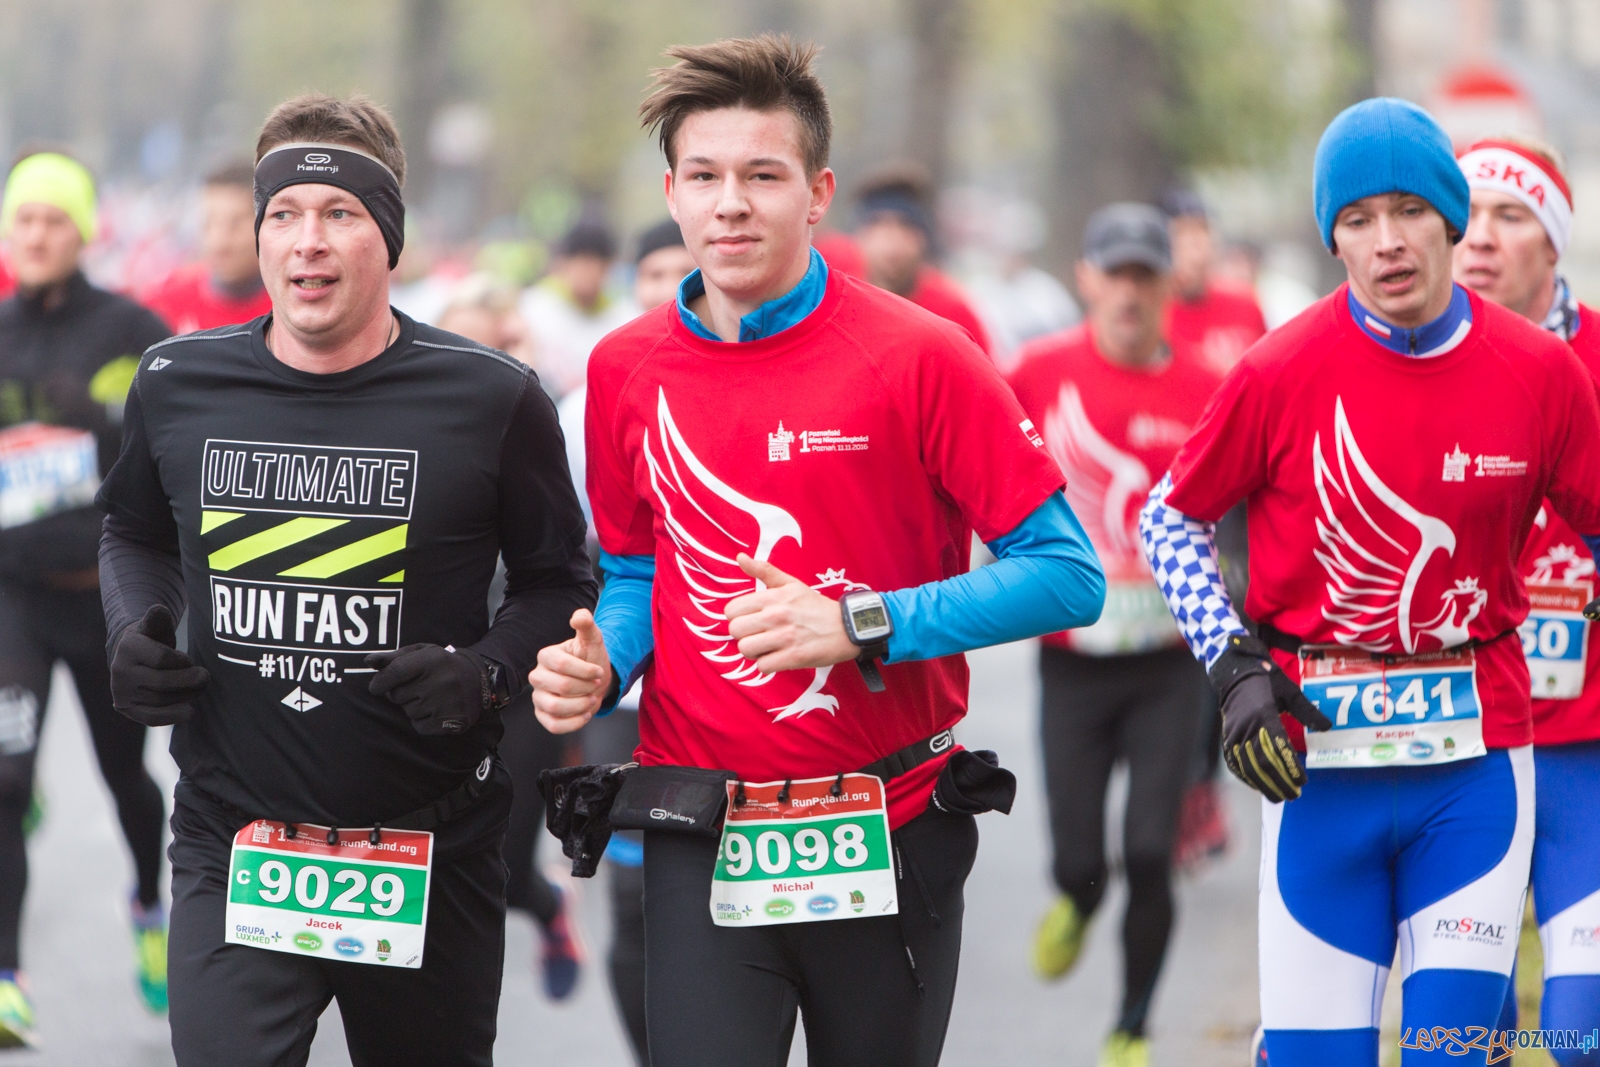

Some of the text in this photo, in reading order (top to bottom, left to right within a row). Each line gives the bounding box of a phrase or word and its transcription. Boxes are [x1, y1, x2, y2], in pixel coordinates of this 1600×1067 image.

[296, 163, 339, 174] Kalenji
[1475, 160, 1545, 208] SKA
[837, 443, 869, 451] 11.11.2016
[207, 449, 410, 507] ULTIMATE
[214, 583, 397, 646] RUN FAST
[1517, 618, 1570, 658] 50
[258, 653, 342, 684] #11/CC.
[1325, 677, 1456, 727] 7641
[1375, 730, 1416, 740] Kacper
[791, 791, 870, 808] RunPoland.org
[667, 811, 696, 825] Kalenji
[725, 823, 869, 877] 9098
[236, 869, 251, 885] C
[258, 859, 405, 917] 9029
[772, 881, 814, 893] Michał
[716, 902, 737, 912] GRUPA
[716, 911, 742, 921] LUXMED
[235, 924, 265, 936] GRUPA
[306, 917, 343, 931] Jacek
[1435, 918, 1506, 940] POSTAL
[235, 932, 270, 945] LUXMED
[1432, 932, 1503, 946] STEEL GROUP
